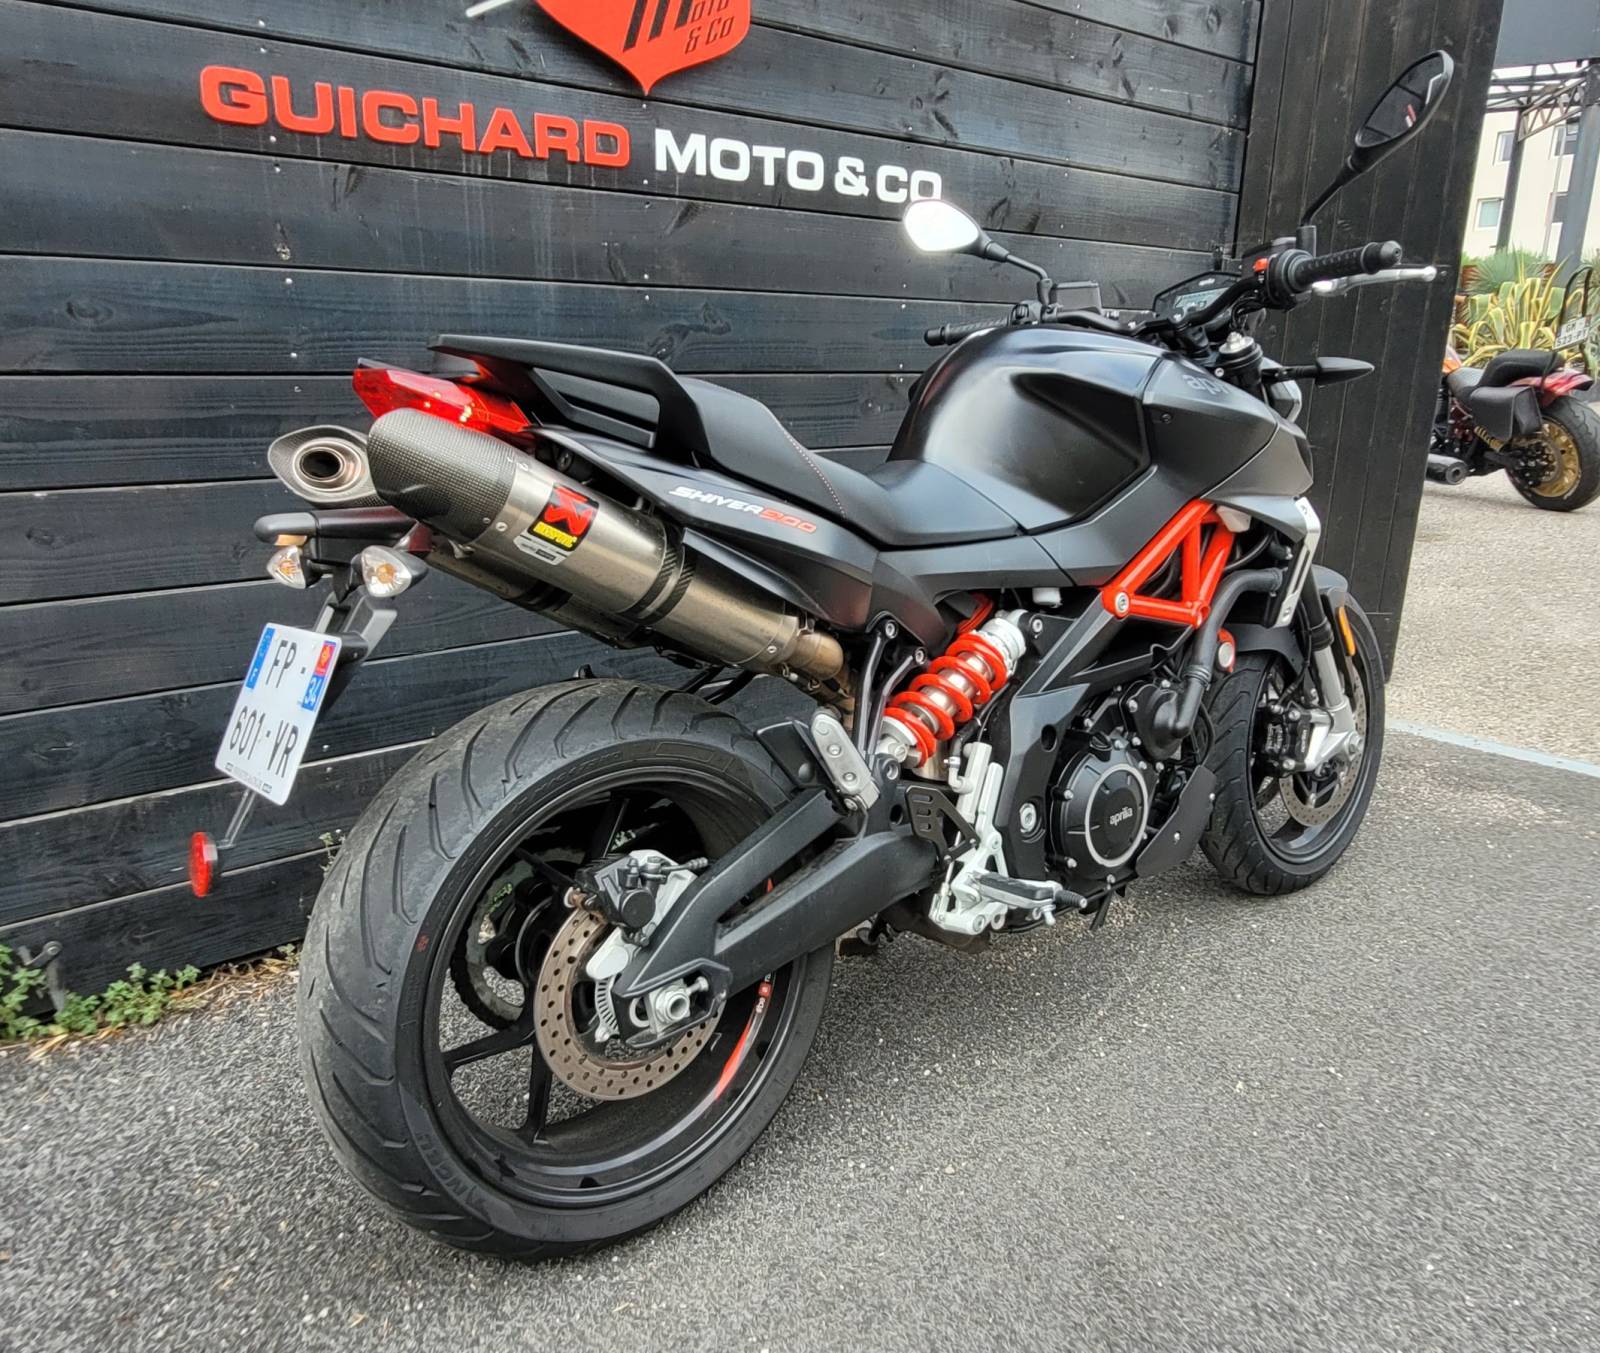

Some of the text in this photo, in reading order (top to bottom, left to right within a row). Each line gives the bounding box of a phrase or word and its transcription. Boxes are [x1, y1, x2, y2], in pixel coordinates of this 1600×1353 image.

[685, 26, 702, 54] &
[200, 65, 943, 203] GUICHARD MOTO & CO
